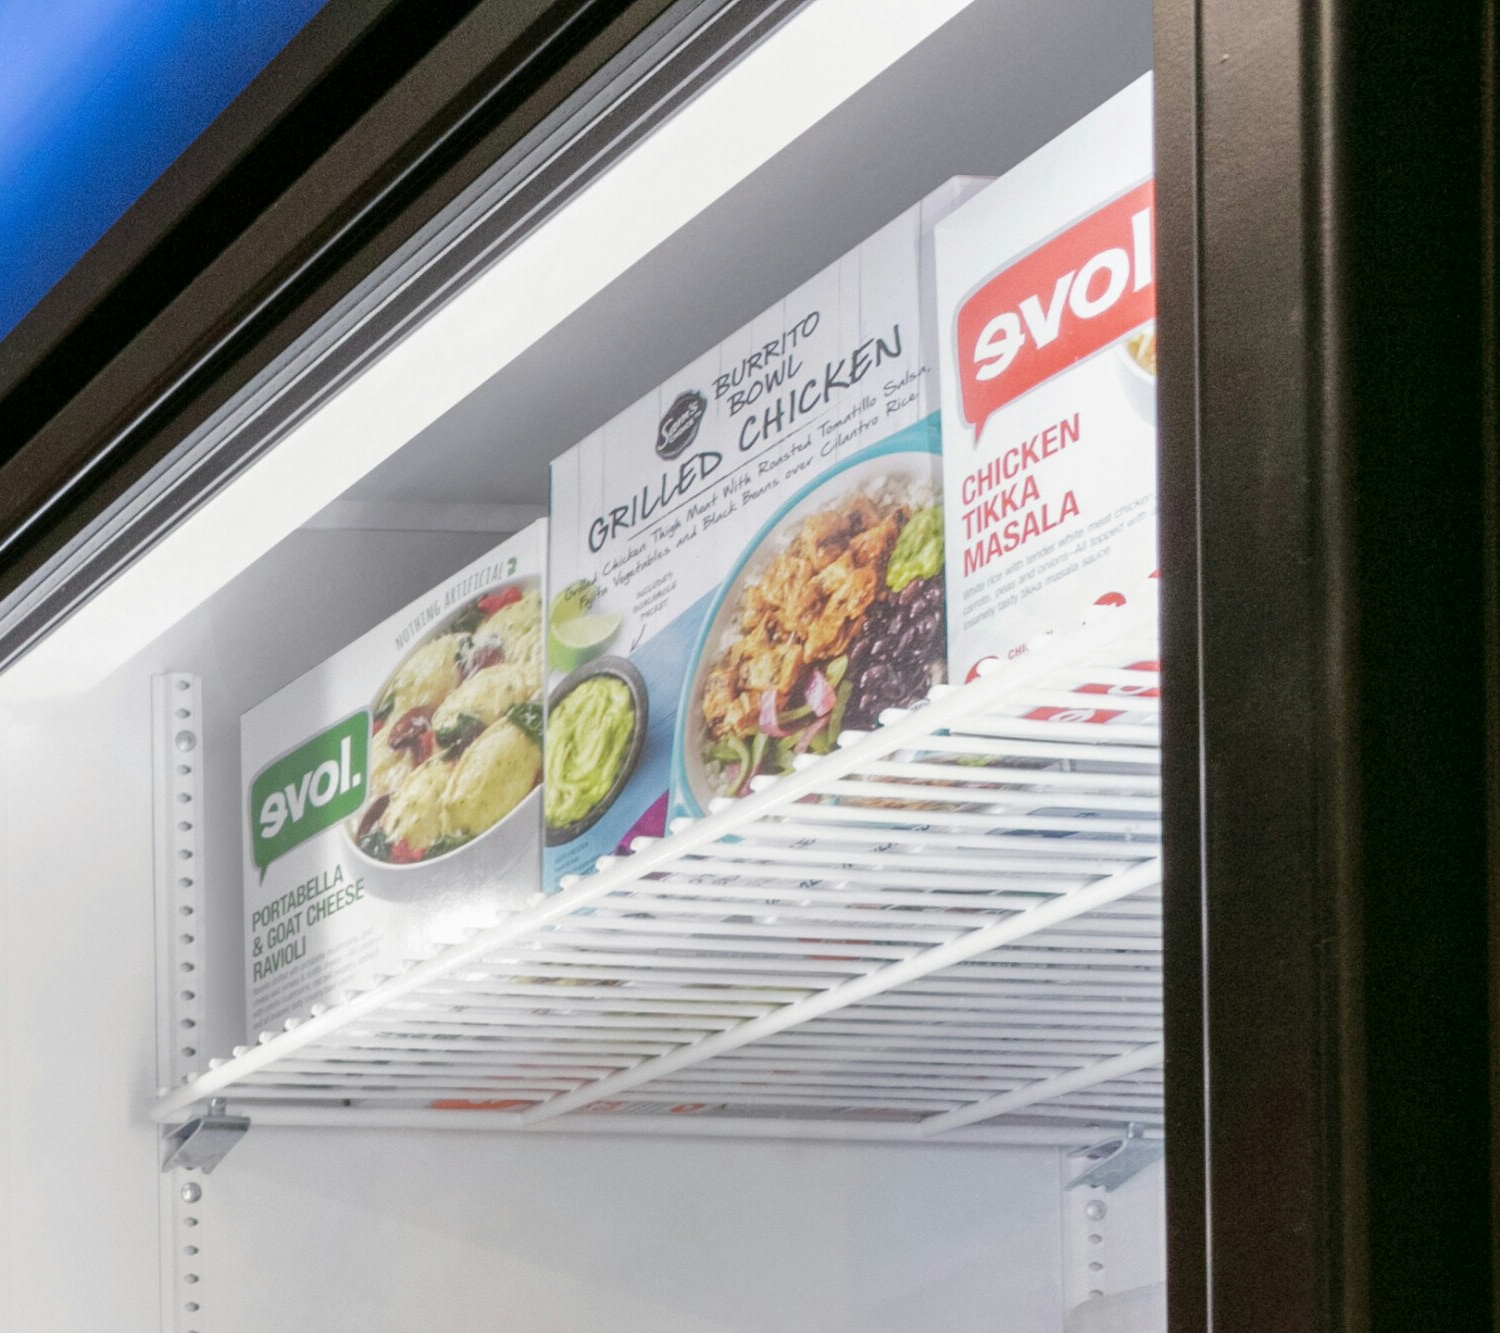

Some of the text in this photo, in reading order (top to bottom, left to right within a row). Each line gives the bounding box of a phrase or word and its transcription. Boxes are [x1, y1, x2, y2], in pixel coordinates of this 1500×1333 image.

[712, 311, 820, 400] BURRITO
[728, 358, 804, 417] BOWL
[588, 324, 903, 553] GRILLED CHICKEN
[650, 519, 682, 544] Thigh
[686, 495, 718, 521] Meat
[758, 436, 812, 476] Roasted
[818, 396, 876, 437] Tomatillo
[962, 412, 1081, 506] CHICKEN
[613, 391, 920, 587] Vegetables and Black Beans over Cilantro Rice
[962, 474, 1041, 541] TIKKA
[962, 489, 1080, 578] MASALA
[395, 601, 442, 651] NOTHING
[251, 865, 345, 933] PORTABELLA
[252, 878, 366, 958] & GOAT CHEESE
[252, 936, 307, 983] RAVIOLI
